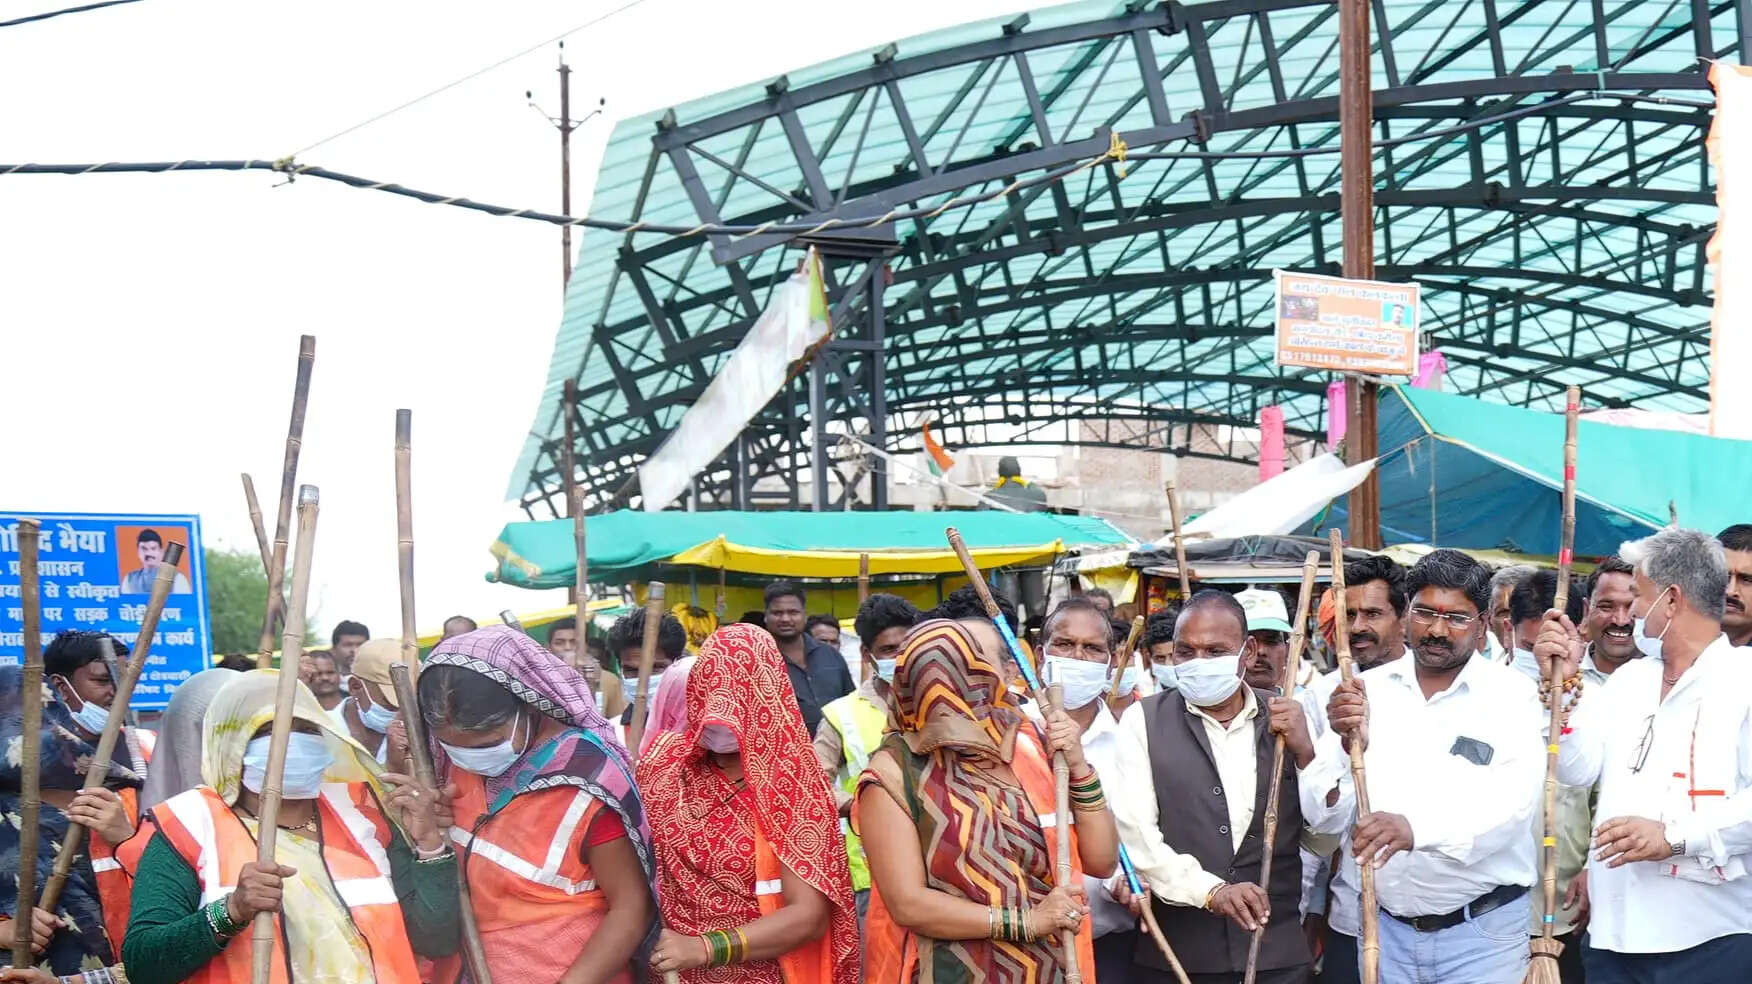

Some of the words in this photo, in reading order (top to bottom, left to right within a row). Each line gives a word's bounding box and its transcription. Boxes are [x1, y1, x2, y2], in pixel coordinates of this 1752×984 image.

[56, 523, 106, 553] भैया
[44, 581, 60, 598] से
[67, 582, 120, 602] स्वीकृत
[44, 607, 63, 621] पर
